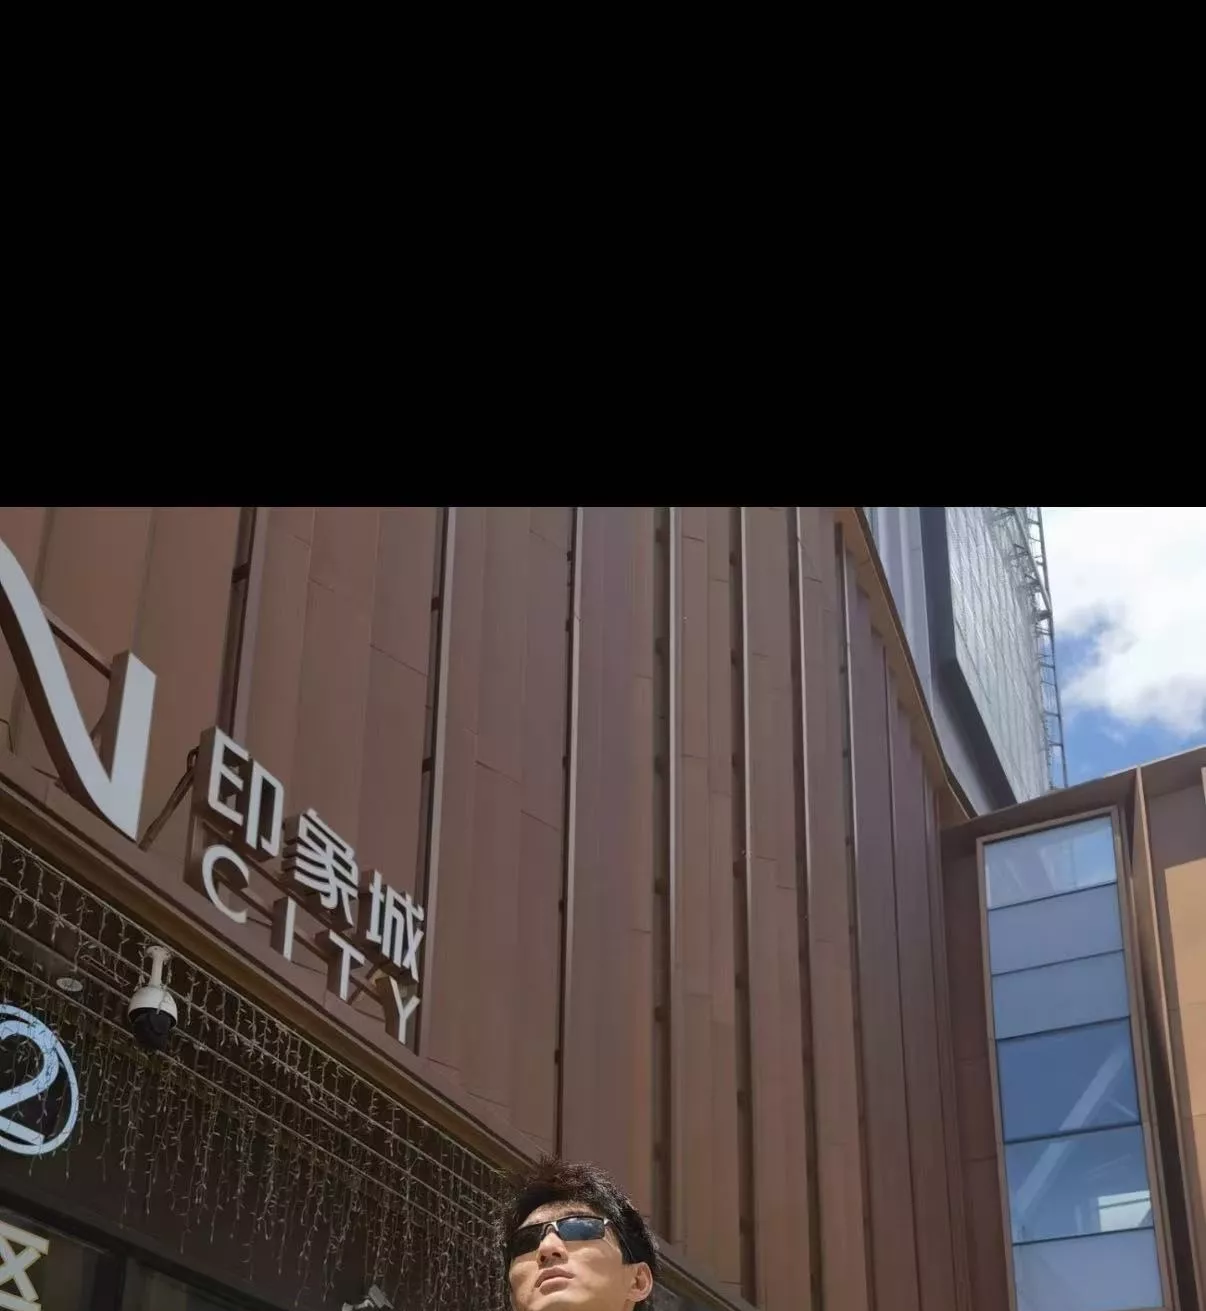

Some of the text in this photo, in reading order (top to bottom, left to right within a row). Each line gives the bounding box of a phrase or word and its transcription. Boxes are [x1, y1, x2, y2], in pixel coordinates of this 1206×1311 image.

[201, 843, 421, 1045] CITY
[207, 726, 425, 982] 印象城
